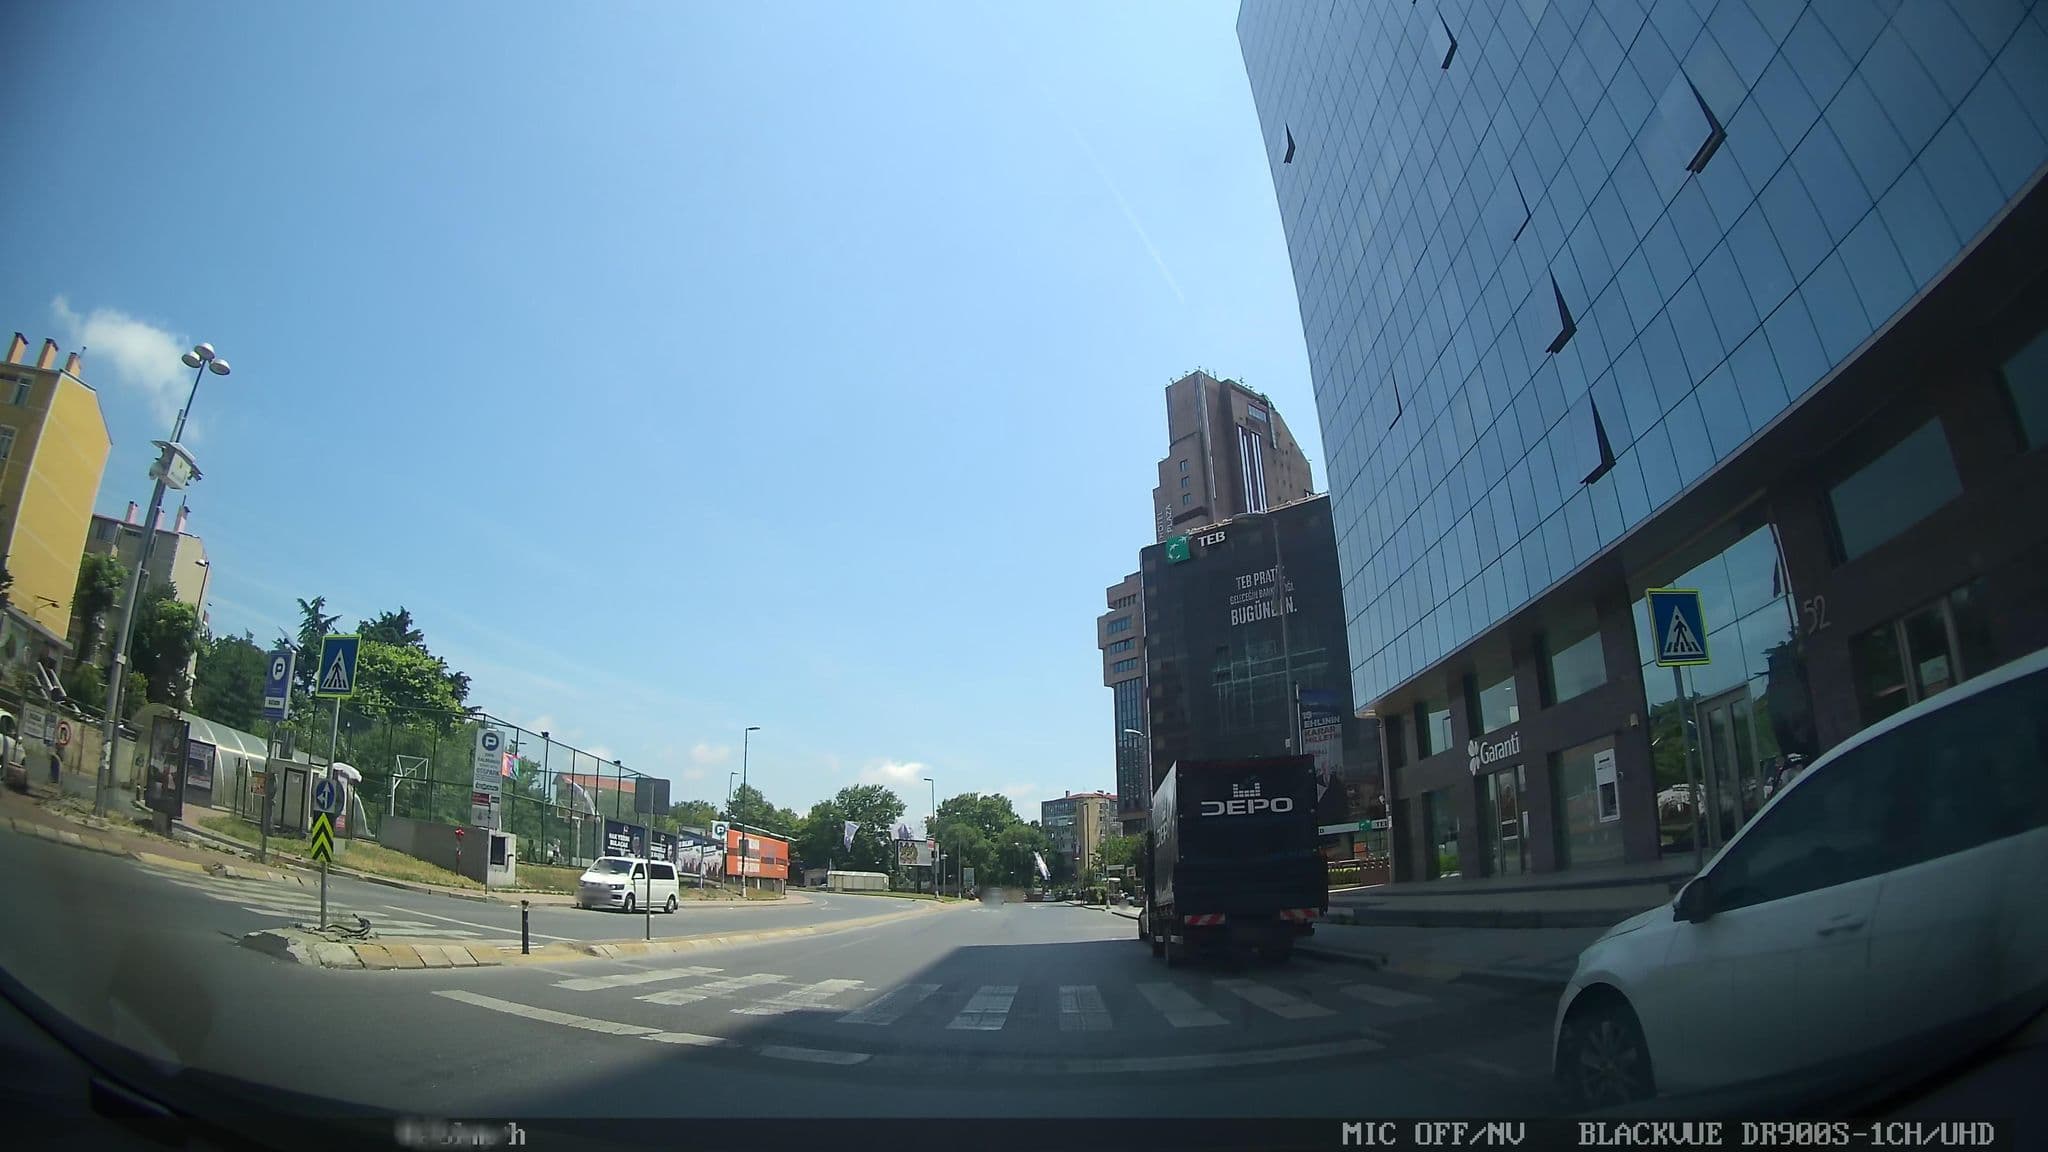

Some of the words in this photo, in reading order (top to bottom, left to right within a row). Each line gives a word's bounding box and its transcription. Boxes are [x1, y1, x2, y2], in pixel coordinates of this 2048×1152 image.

[1165, 503, 1173, 533] PLAZA
[1197, 531, 1226, 547] TEB
[1235, 574, 1252, 590] TEB
[1803, 595, 1832, 635] 52
[1480, 731, 1520, 764] Garanti
[1201, 796, 1295, 817] DEPO
